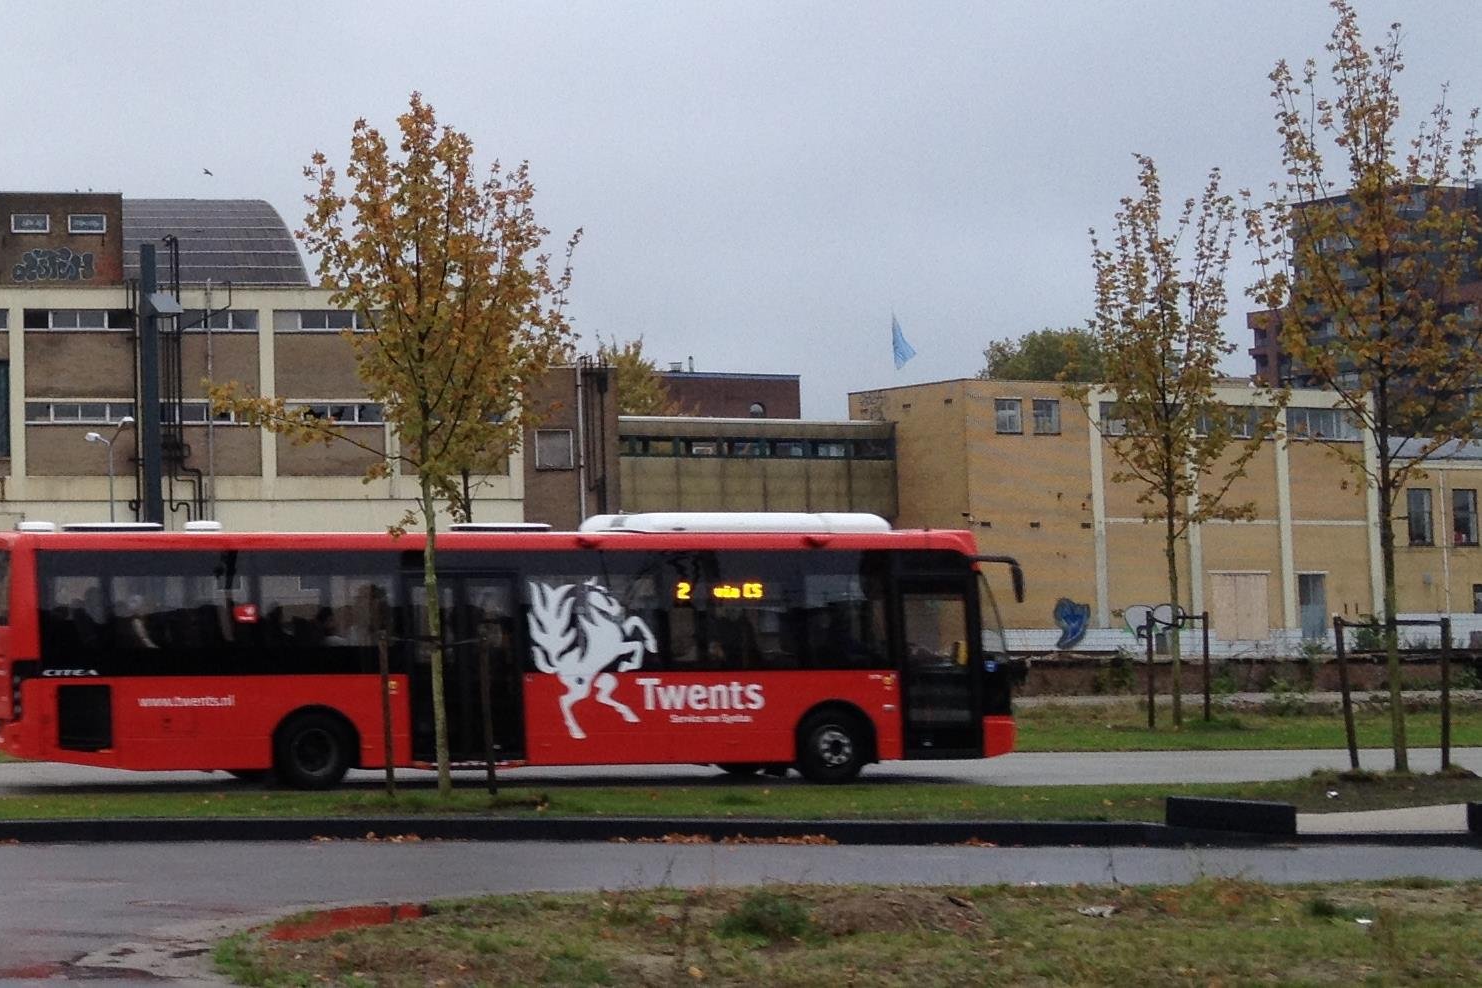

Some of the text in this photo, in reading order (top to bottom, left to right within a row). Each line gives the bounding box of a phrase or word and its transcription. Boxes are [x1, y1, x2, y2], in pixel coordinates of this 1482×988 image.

[676, 582, 691, 599] 2
[138, 695, 236, 707] www.twents.nl
[635, 677, 765, 710] Twents
